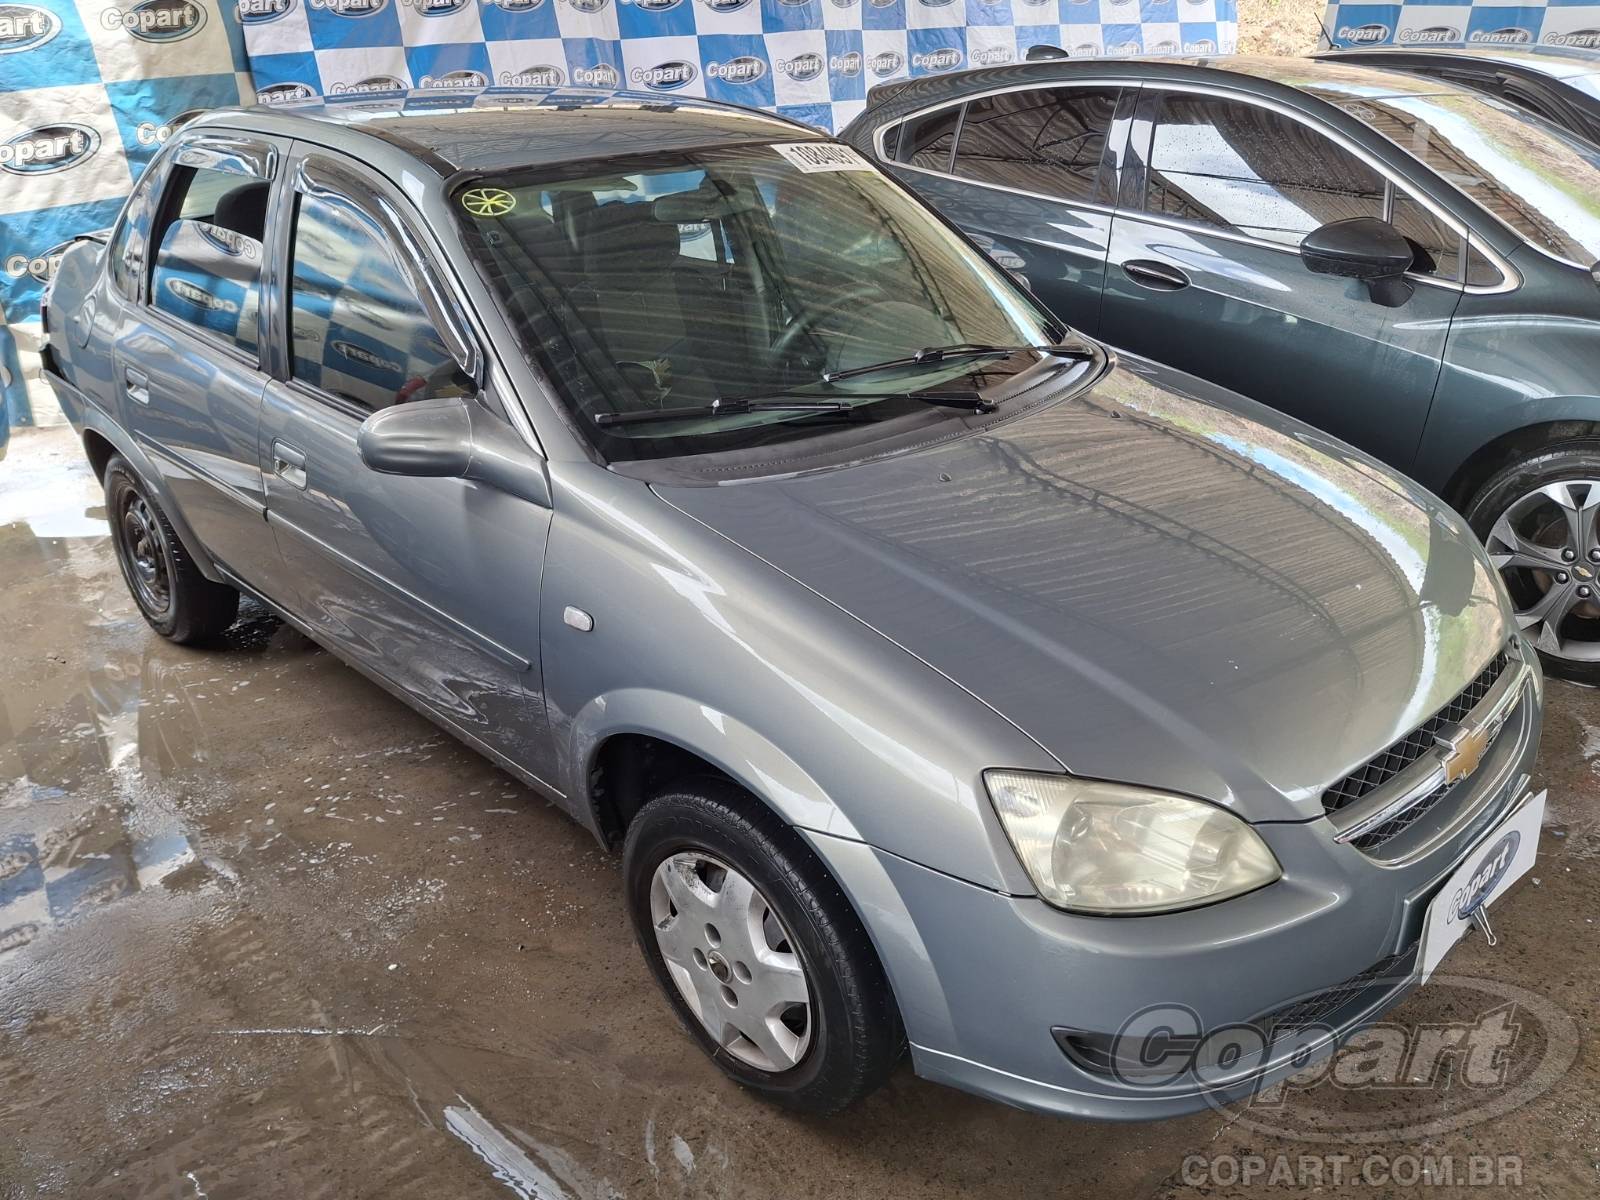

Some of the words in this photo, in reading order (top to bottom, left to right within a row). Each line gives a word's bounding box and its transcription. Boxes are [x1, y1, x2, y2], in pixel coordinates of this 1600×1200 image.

[0, 10, 45, 37] art
[100, 4, 196, 33] Copart
[1338, 26, 1385, 41] Copart
[1399, 28, 1451, 43] Copart
[706, 60, 761, 80] Copart
[774, 57, 821, 76] Copart
[866, 55, 898, 72] Copart
[911, 51, 957, 70] Copart
[500, 70, 556, 86] Copart
[631, 65, 690, 86] Copart
[0, 130, 85, 167] opart
[1447, 841, 1512, 925] Copart
